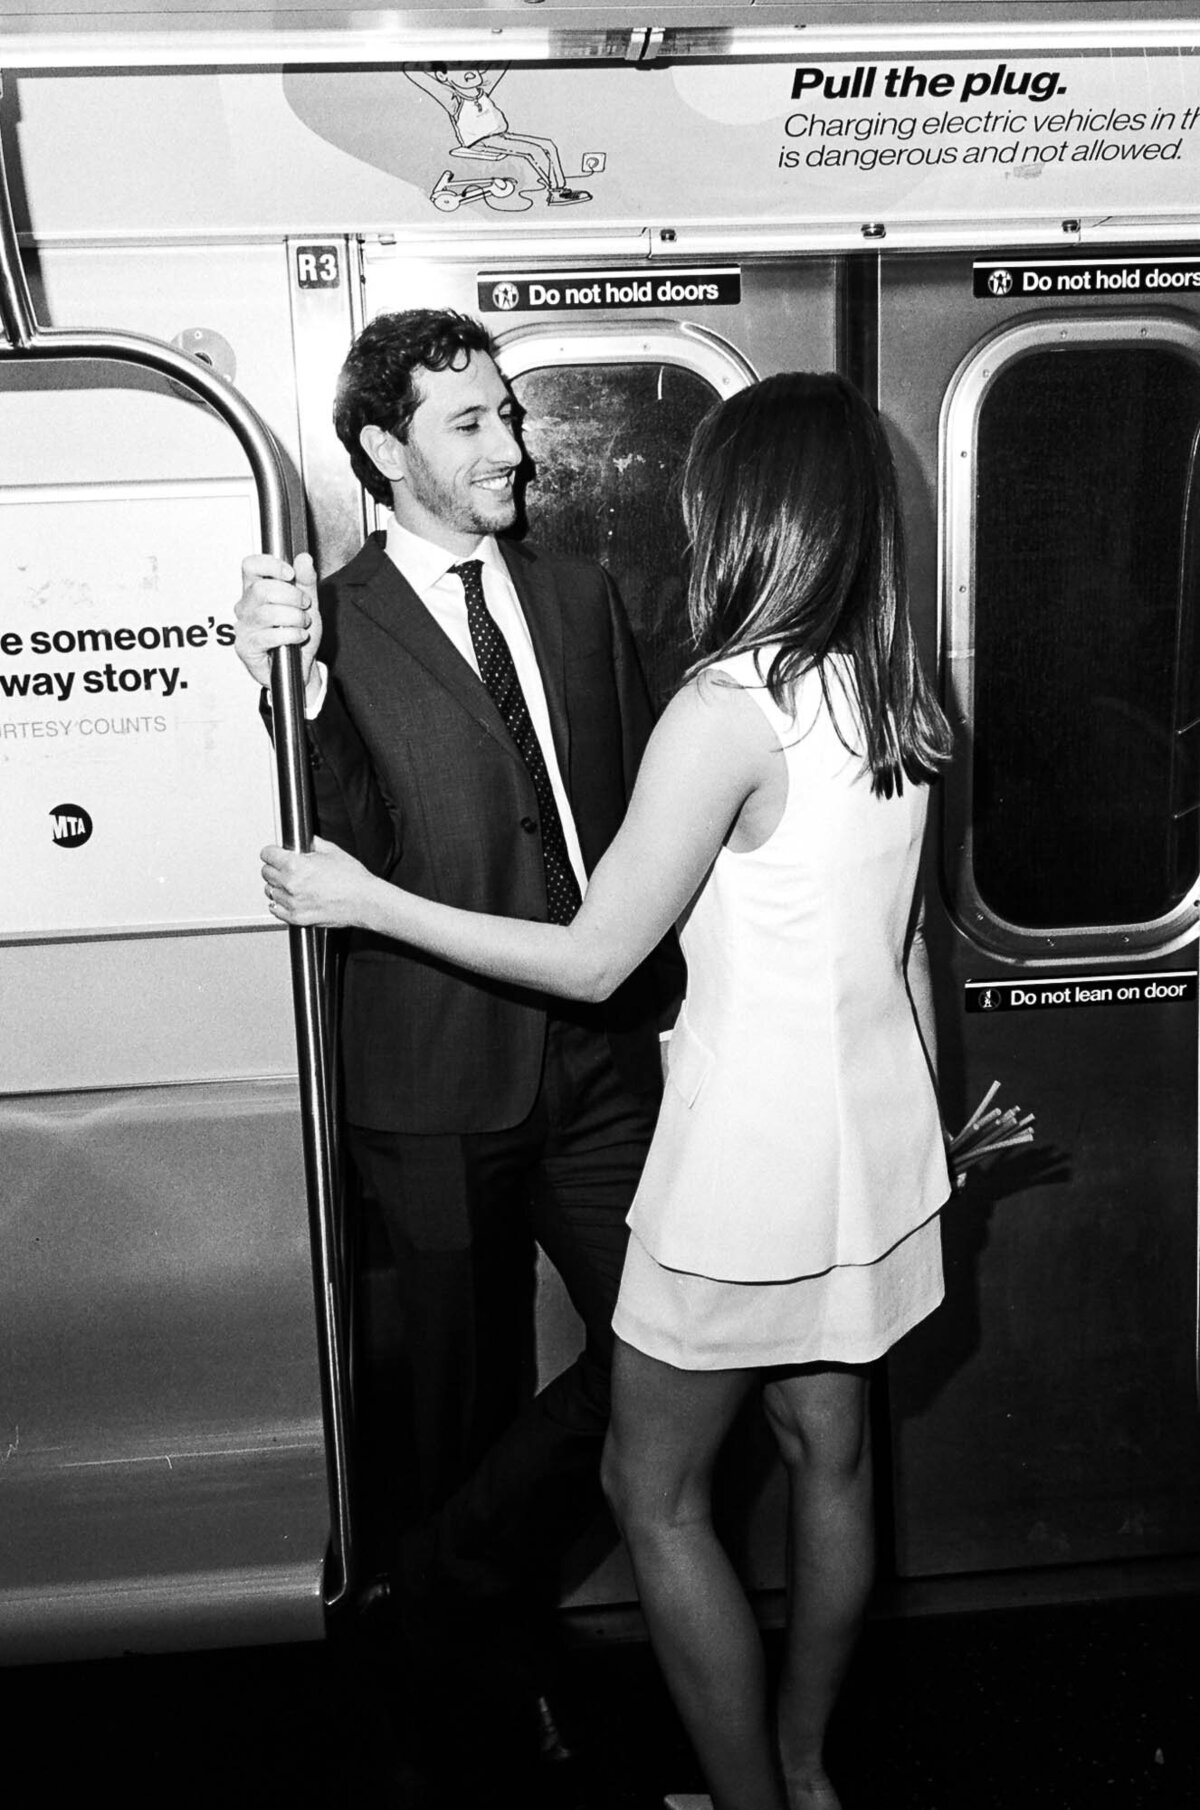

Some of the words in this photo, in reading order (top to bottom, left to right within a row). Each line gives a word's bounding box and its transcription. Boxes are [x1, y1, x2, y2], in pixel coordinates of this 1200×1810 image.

[790, 66, 878, 100] Pull
[884, 65, 955, 98] the
[959, 63, 1067, 103] plug.
[784, 112, 917, 141] Charging
[922, 109, 1028, 135] electric
[1034, 108, 1147, 133] vehicles
[1150, 107, 1176, 131] in
[778, 145, 800, 168] is
[805, 144, 958, 171] dangerous
[962, 141, 1020, 164] and
[1021, 140, 1069, 163] not
[1071, 137, 1183, 162] allowed.
[298, 253, 337, 281] R3
[1022, 271, 1053, 291] Do
[1057, 271, 1092, 290] not
[1095, 268, 1141, 289] hold
[528, 284, 561, 306] Do
[565, 284, 602, 304] not
[605, 281, 652, 303] hold
[656, 280, 719, 302] doors
[30, 616, 237, 655] someone's
[83, 663, 188, 697] story.
[0, 720, 72, 739] RTESY
[79, 716, 167, 736] COUNTS
[51, 814, 87, 841] MTA
[1010, 989, 1037, 1006] Do
[1041, 987, 1072, 1004] not
[1075, 986, 1113, 1003] lean
[1117, 987, 1140, 1000] on
[1144, 982, 1188, 999] door
